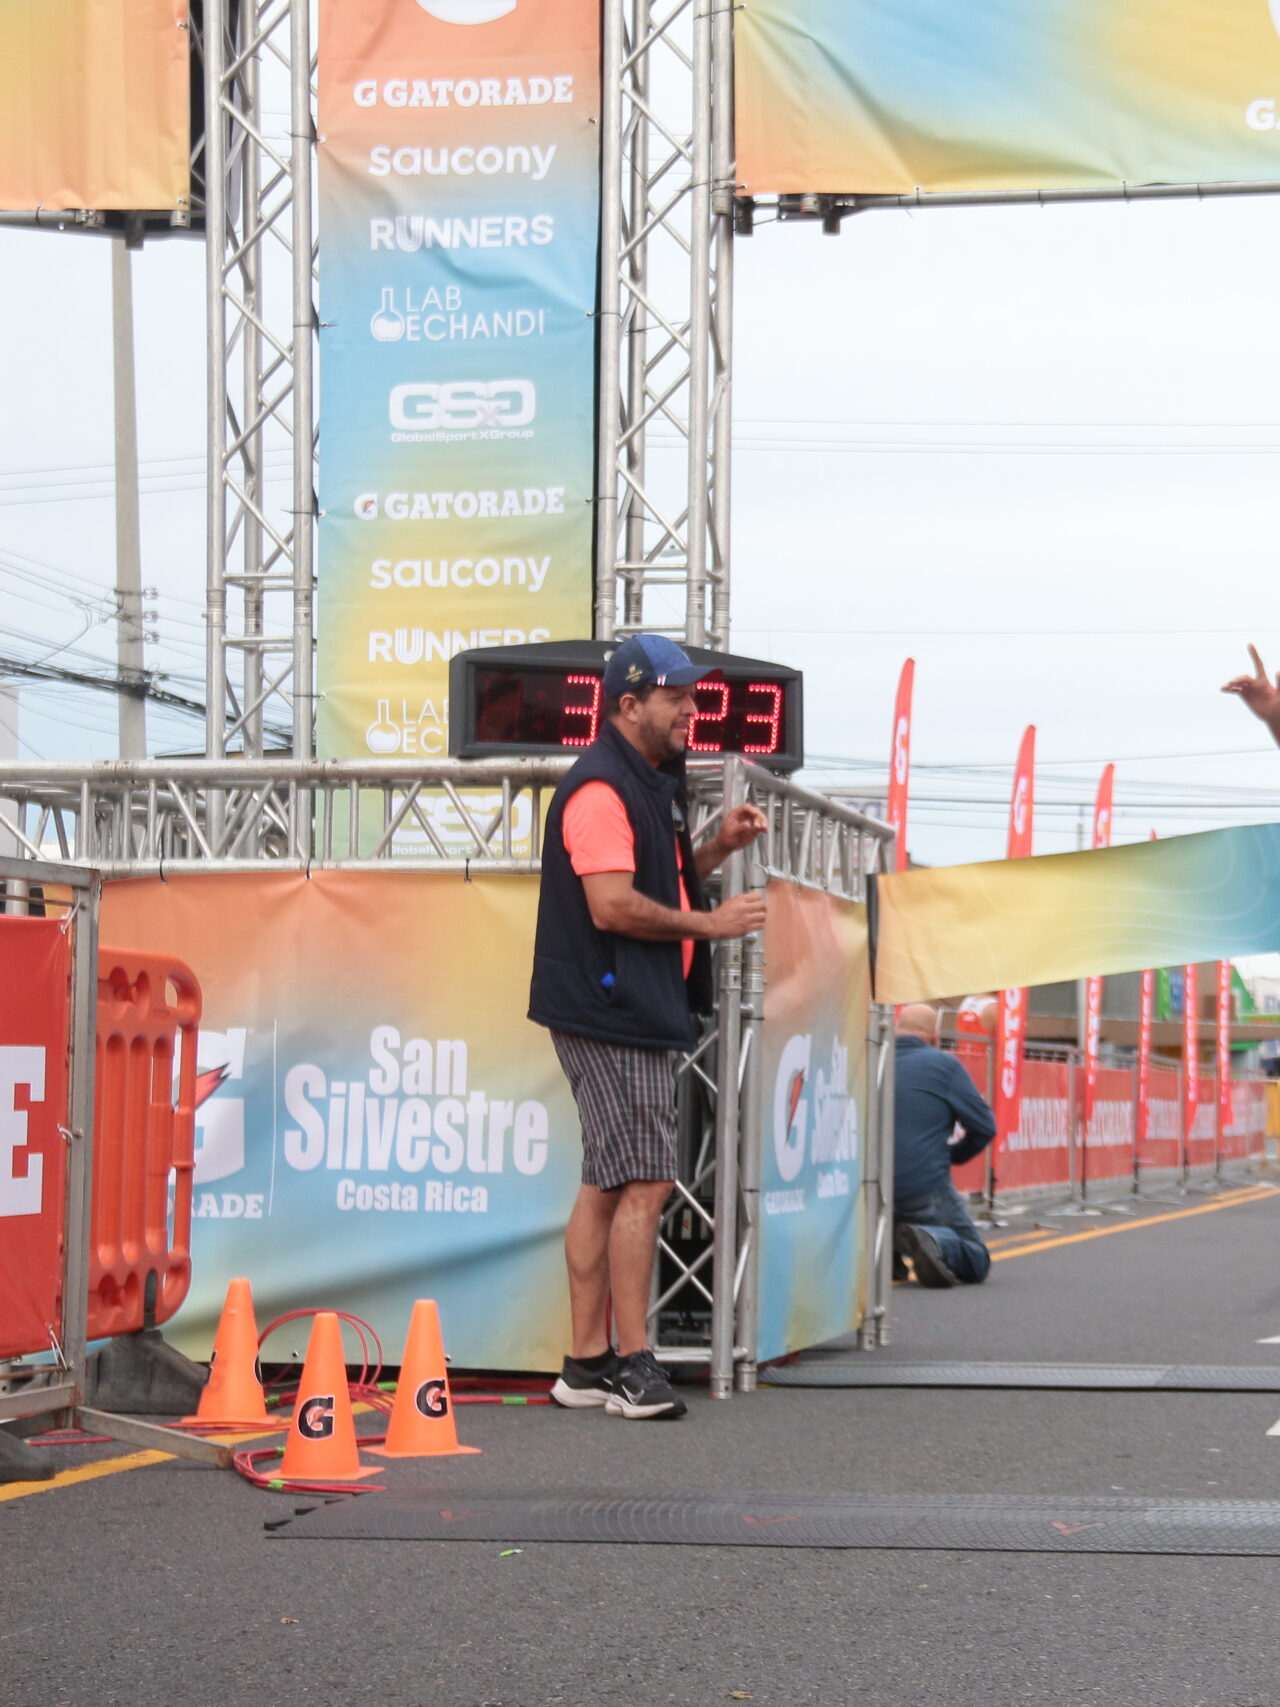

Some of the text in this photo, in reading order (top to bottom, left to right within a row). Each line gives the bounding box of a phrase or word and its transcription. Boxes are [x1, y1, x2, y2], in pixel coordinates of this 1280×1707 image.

[383, 75, 574, 108] GATORADE
[368, 144, 558, 181] saucony
[370, 214, 554, 252] RUNNERS
[406, 286, 463, 313] LAB
[406, 308, 545, 342] ECHANDI
[384, 486, 565, 520] GATORADE
[370, 556, 552, 593] saucony
[402, 698, 449, 725] LA
[1001, 986, 1022, 1099] GATO
[369, 1025, 469, 1097] San
[283, 1063, 549, 1176] Silvestre
[336, 1179, 489, 1213] Costa Rica
